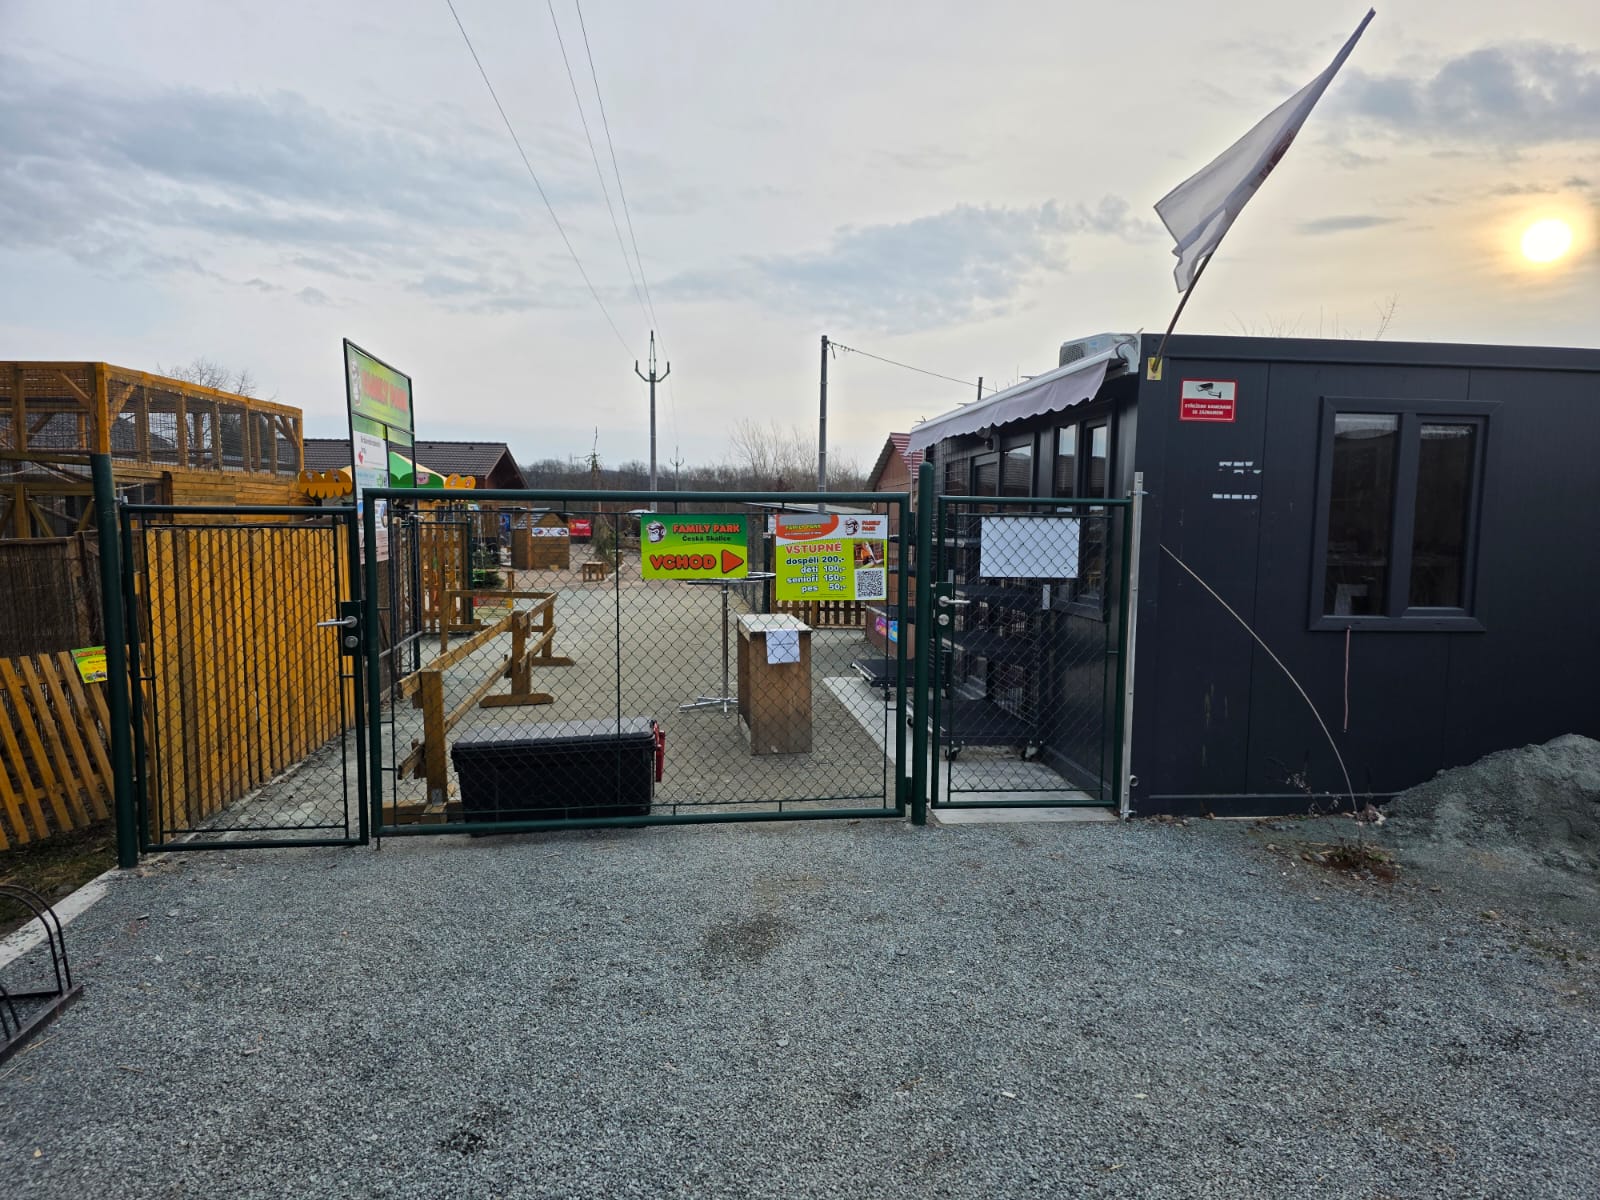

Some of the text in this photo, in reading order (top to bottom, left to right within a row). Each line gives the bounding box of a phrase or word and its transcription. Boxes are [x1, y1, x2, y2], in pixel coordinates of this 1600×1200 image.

[672, 523, 740, 533] FAMILY PARK
[706, 534, 731, 542] Skalice
[785, 542, 842, 554] VSTUPNÉ
[649, 553, 717, 570] VCHOD
[821, 555, 845, 563] 200,-
[823, 565, 846, 573] 100,-
[786, 574, 846, 583] senioři 150,-
[801, 583, 846, 594] pes 50,-
